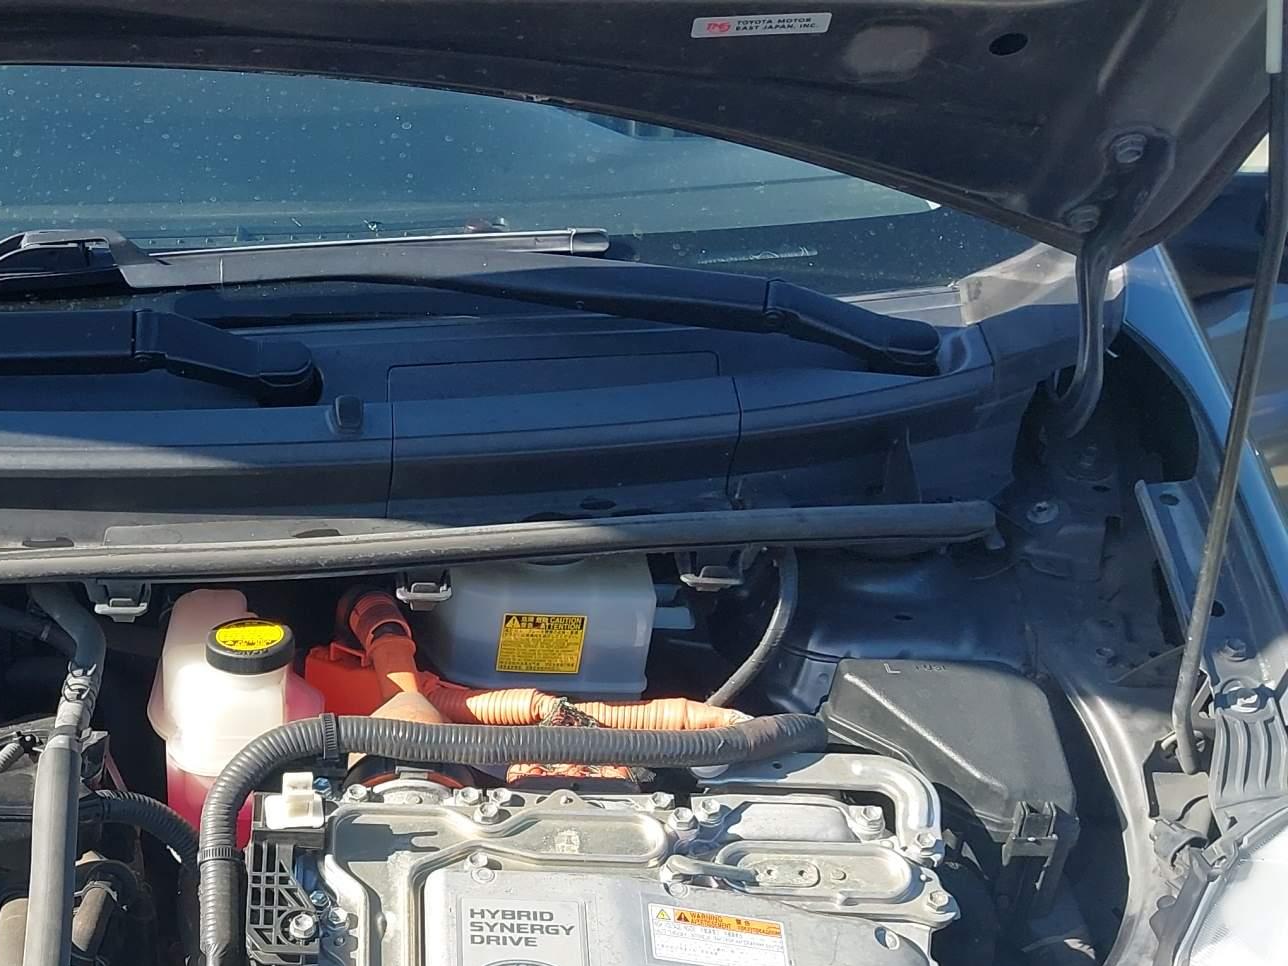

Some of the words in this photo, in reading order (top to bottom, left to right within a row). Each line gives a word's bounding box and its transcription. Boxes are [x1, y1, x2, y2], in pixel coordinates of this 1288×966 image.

[550, 616, 582, 624] CAUTION
[469, 908, 554, 921] HYBRID
[690, 912, 723, 923] WARNING
[469, 921, 575, 936] SYNERGY
[469, 934, 539, 947] DRIVE
